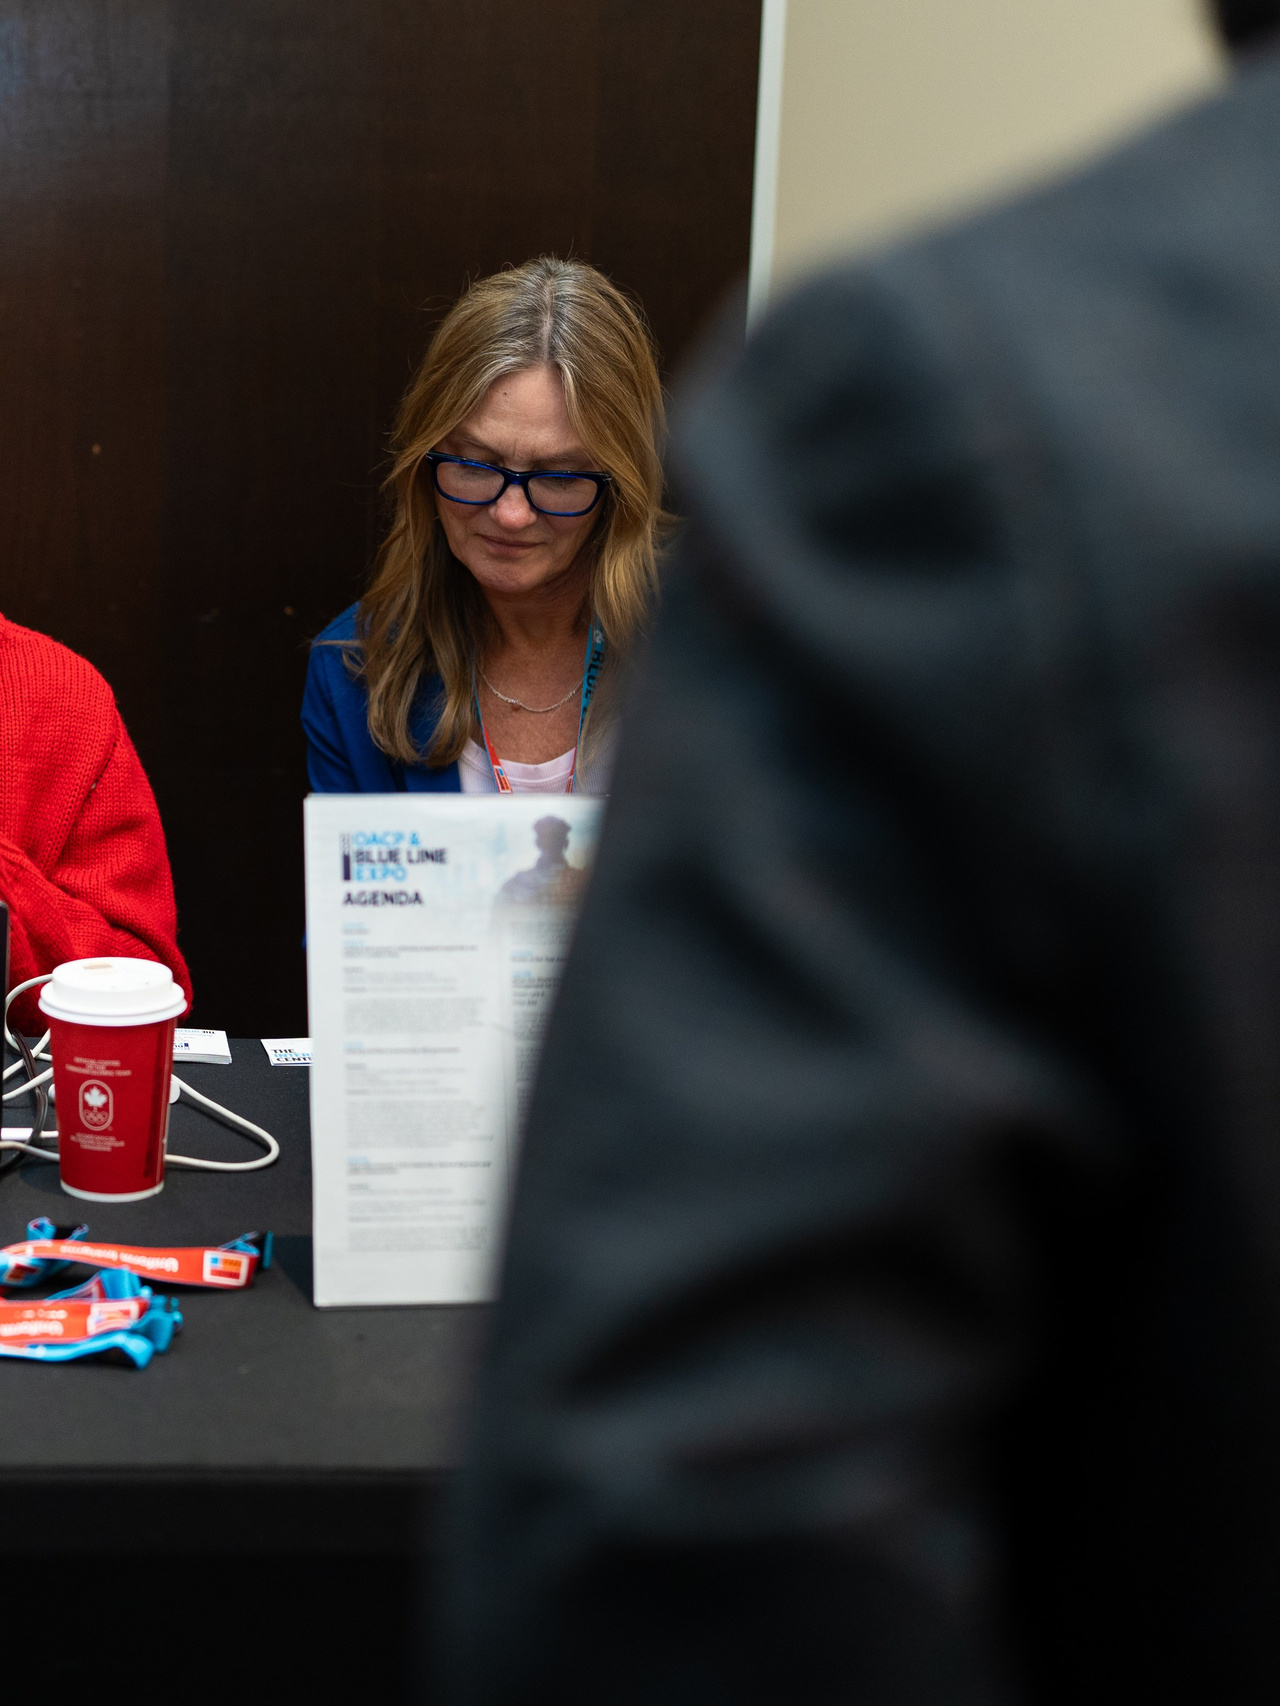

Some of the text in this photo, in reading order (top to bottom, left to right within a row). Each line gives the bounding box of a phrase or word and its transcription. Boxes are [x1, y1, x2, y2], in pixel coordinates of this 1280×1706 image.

[355, 848, 448, 864] BLUE LINE
[356, 864, 407, 882] EXPO
[343, 890, 424, 905] AGENDA
